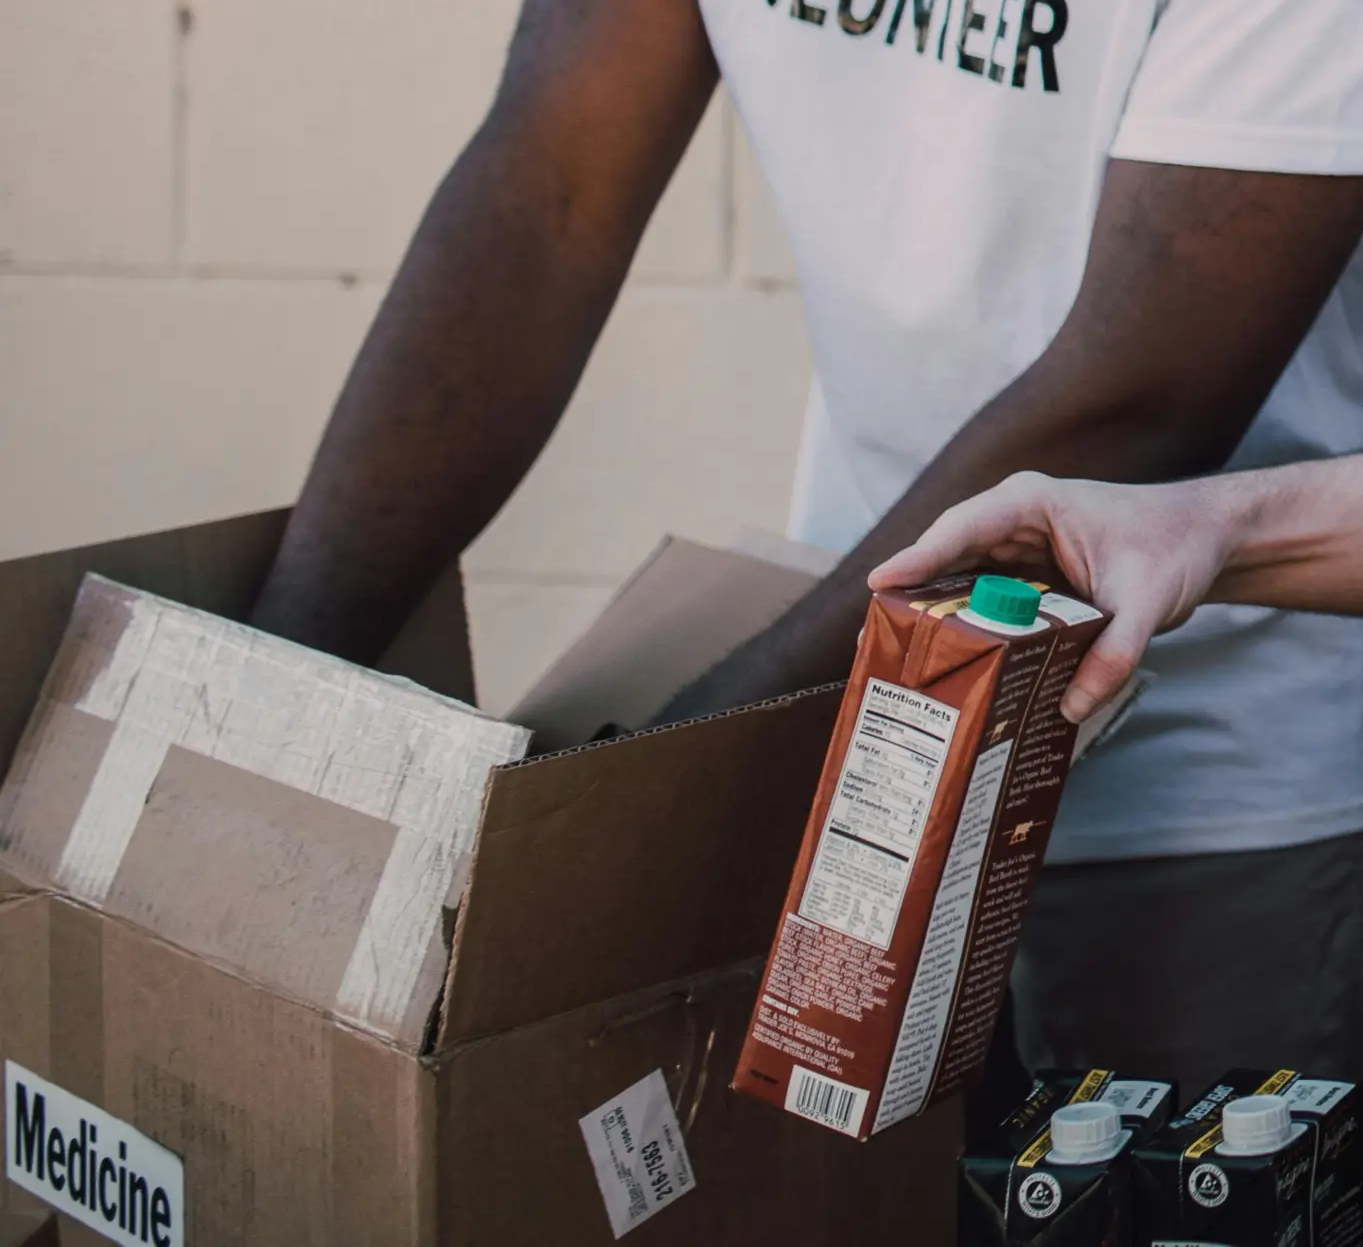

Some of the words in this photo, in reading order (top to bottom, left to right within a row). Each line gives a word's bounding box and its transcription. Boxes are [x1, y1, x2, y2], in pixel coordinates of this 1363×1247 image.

[870, 681, 922, 710] Nutrition
[922, 701, 953, 723] Facts
[16, 1081, 171, 1247] Medicine
[639, 1138, 673, 1203] 216-7563
